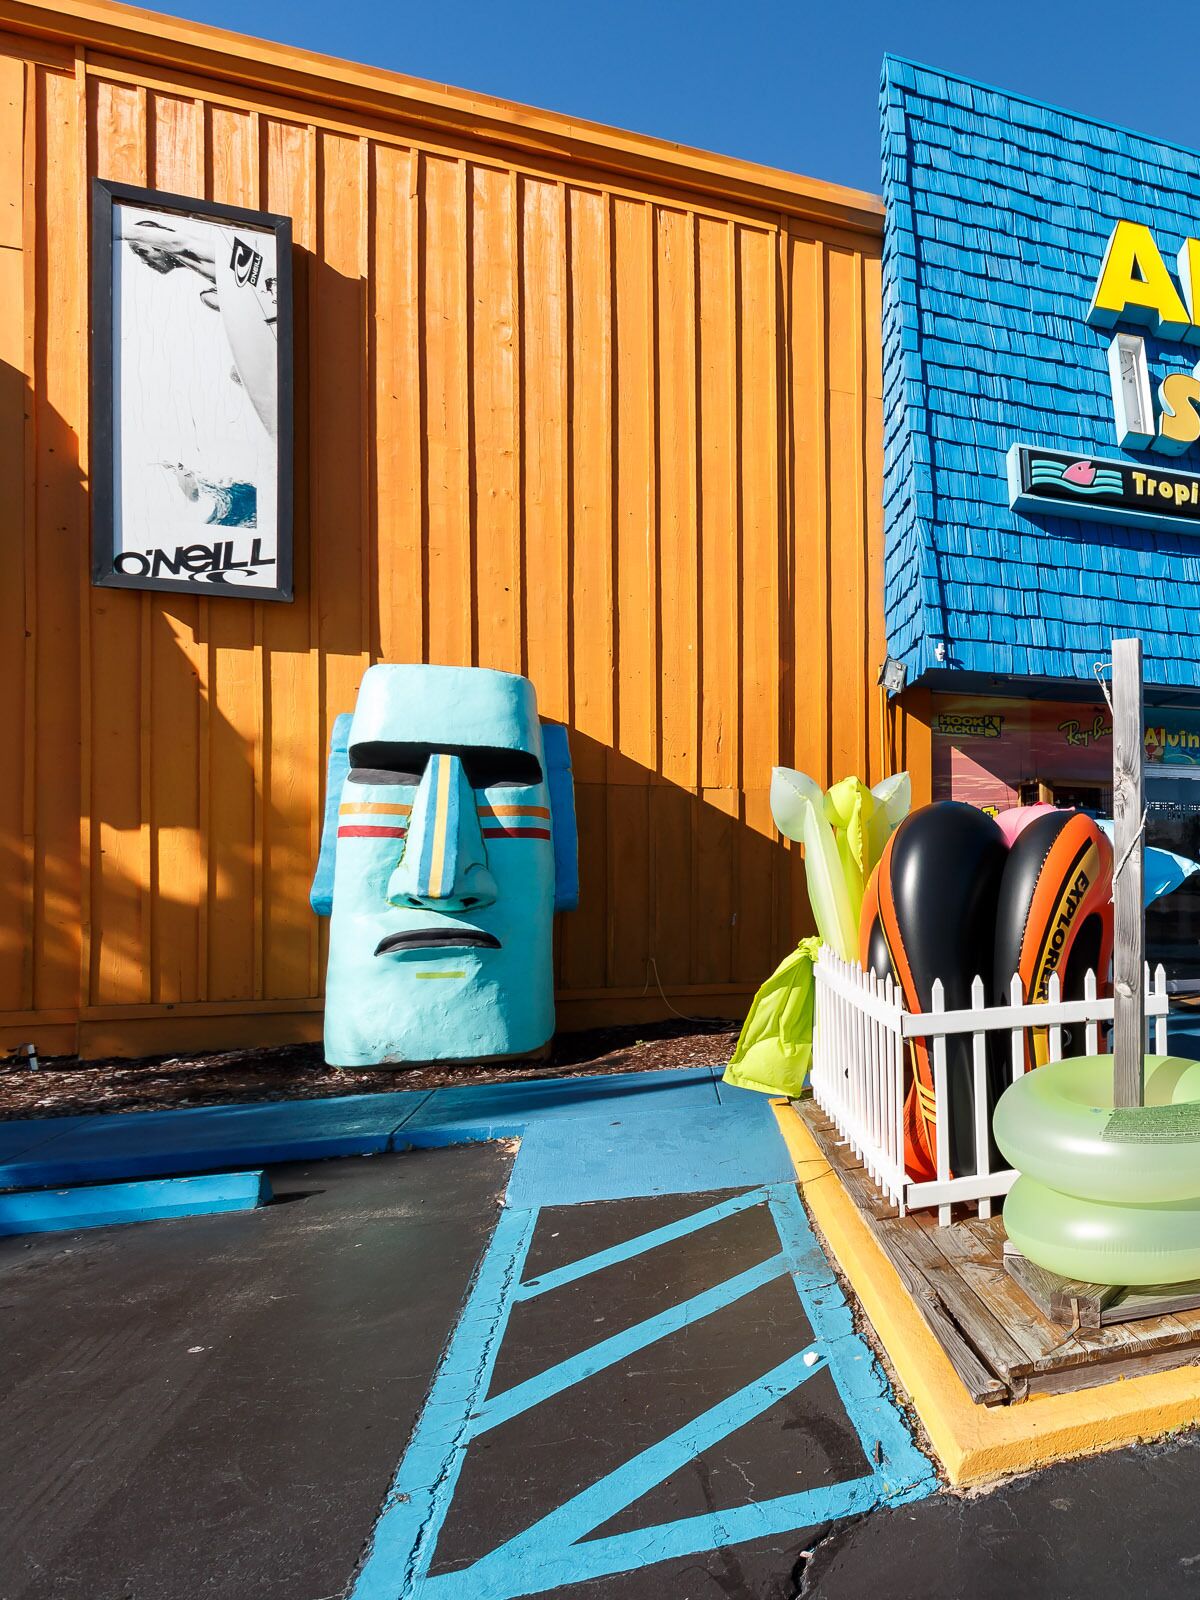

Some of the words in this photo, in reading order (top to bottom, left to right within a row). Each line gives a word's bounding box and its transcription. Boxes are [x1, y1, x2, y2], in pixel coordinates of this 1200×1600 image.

[939, 715, 984, 726] HOOK
[941, 724, 985, 735] TACKLE
[1037, 870, 1089, 1000] EXPLORER
